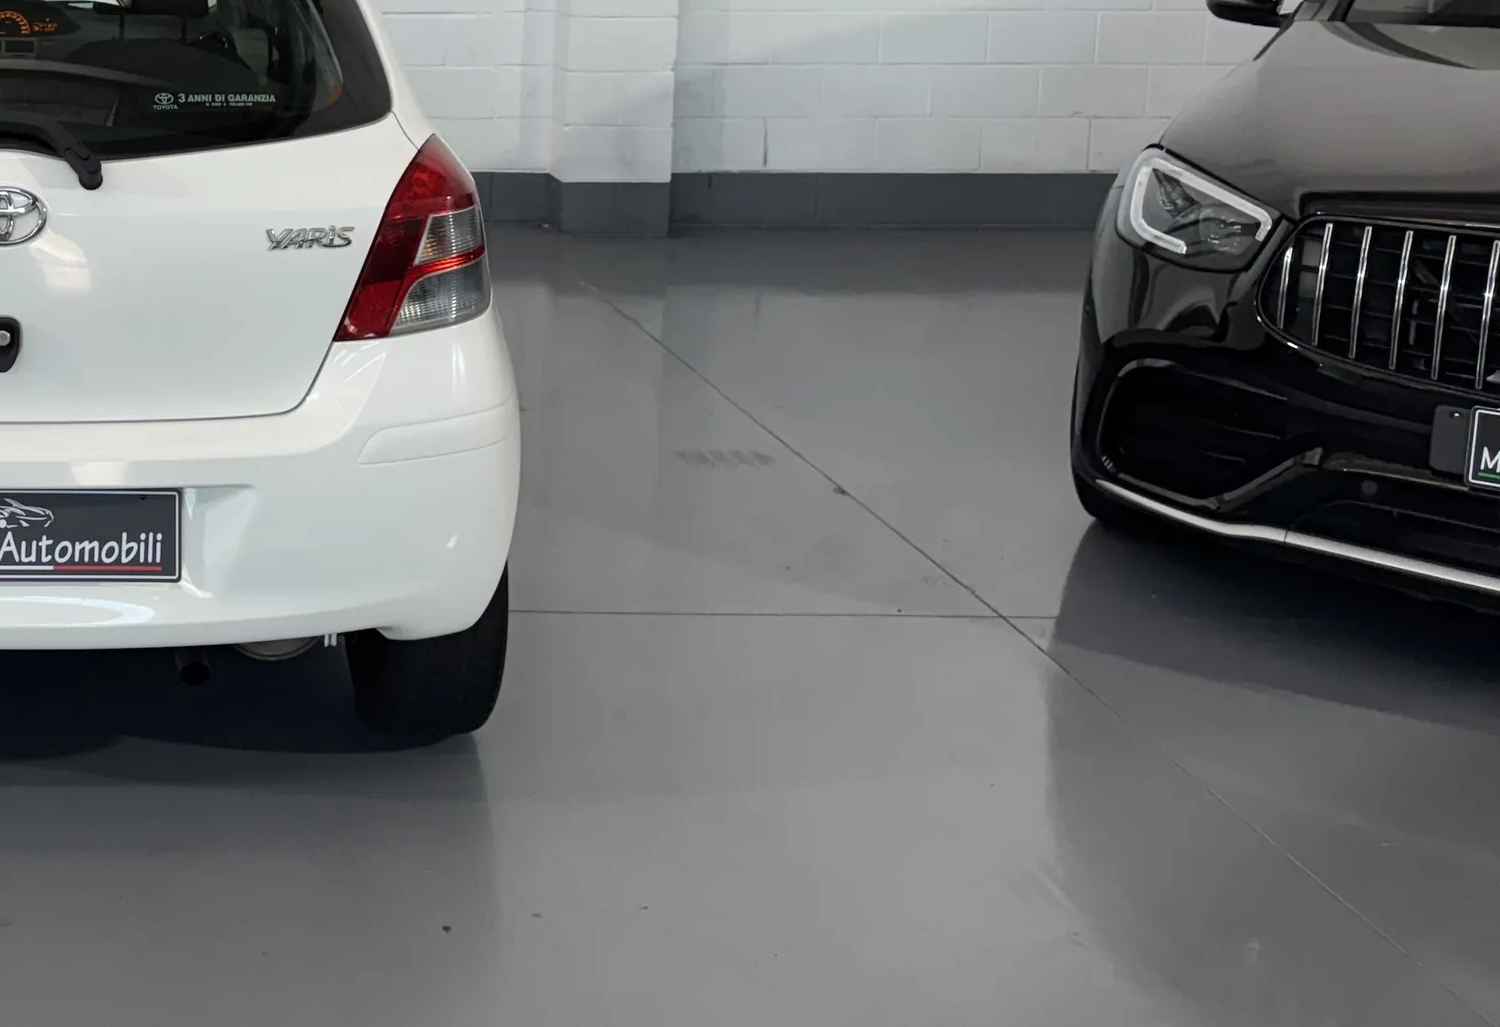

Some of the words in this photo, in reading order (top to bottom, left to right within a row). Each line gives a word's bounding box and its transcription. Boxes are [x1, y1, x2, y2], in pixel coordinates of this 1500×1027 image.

[178, 93, 186, 103] 3
[187, 94, 212, 103] ANNI
[214, 93, 226, 103] DI
[228, 94, 276, 103] GARANZIA
